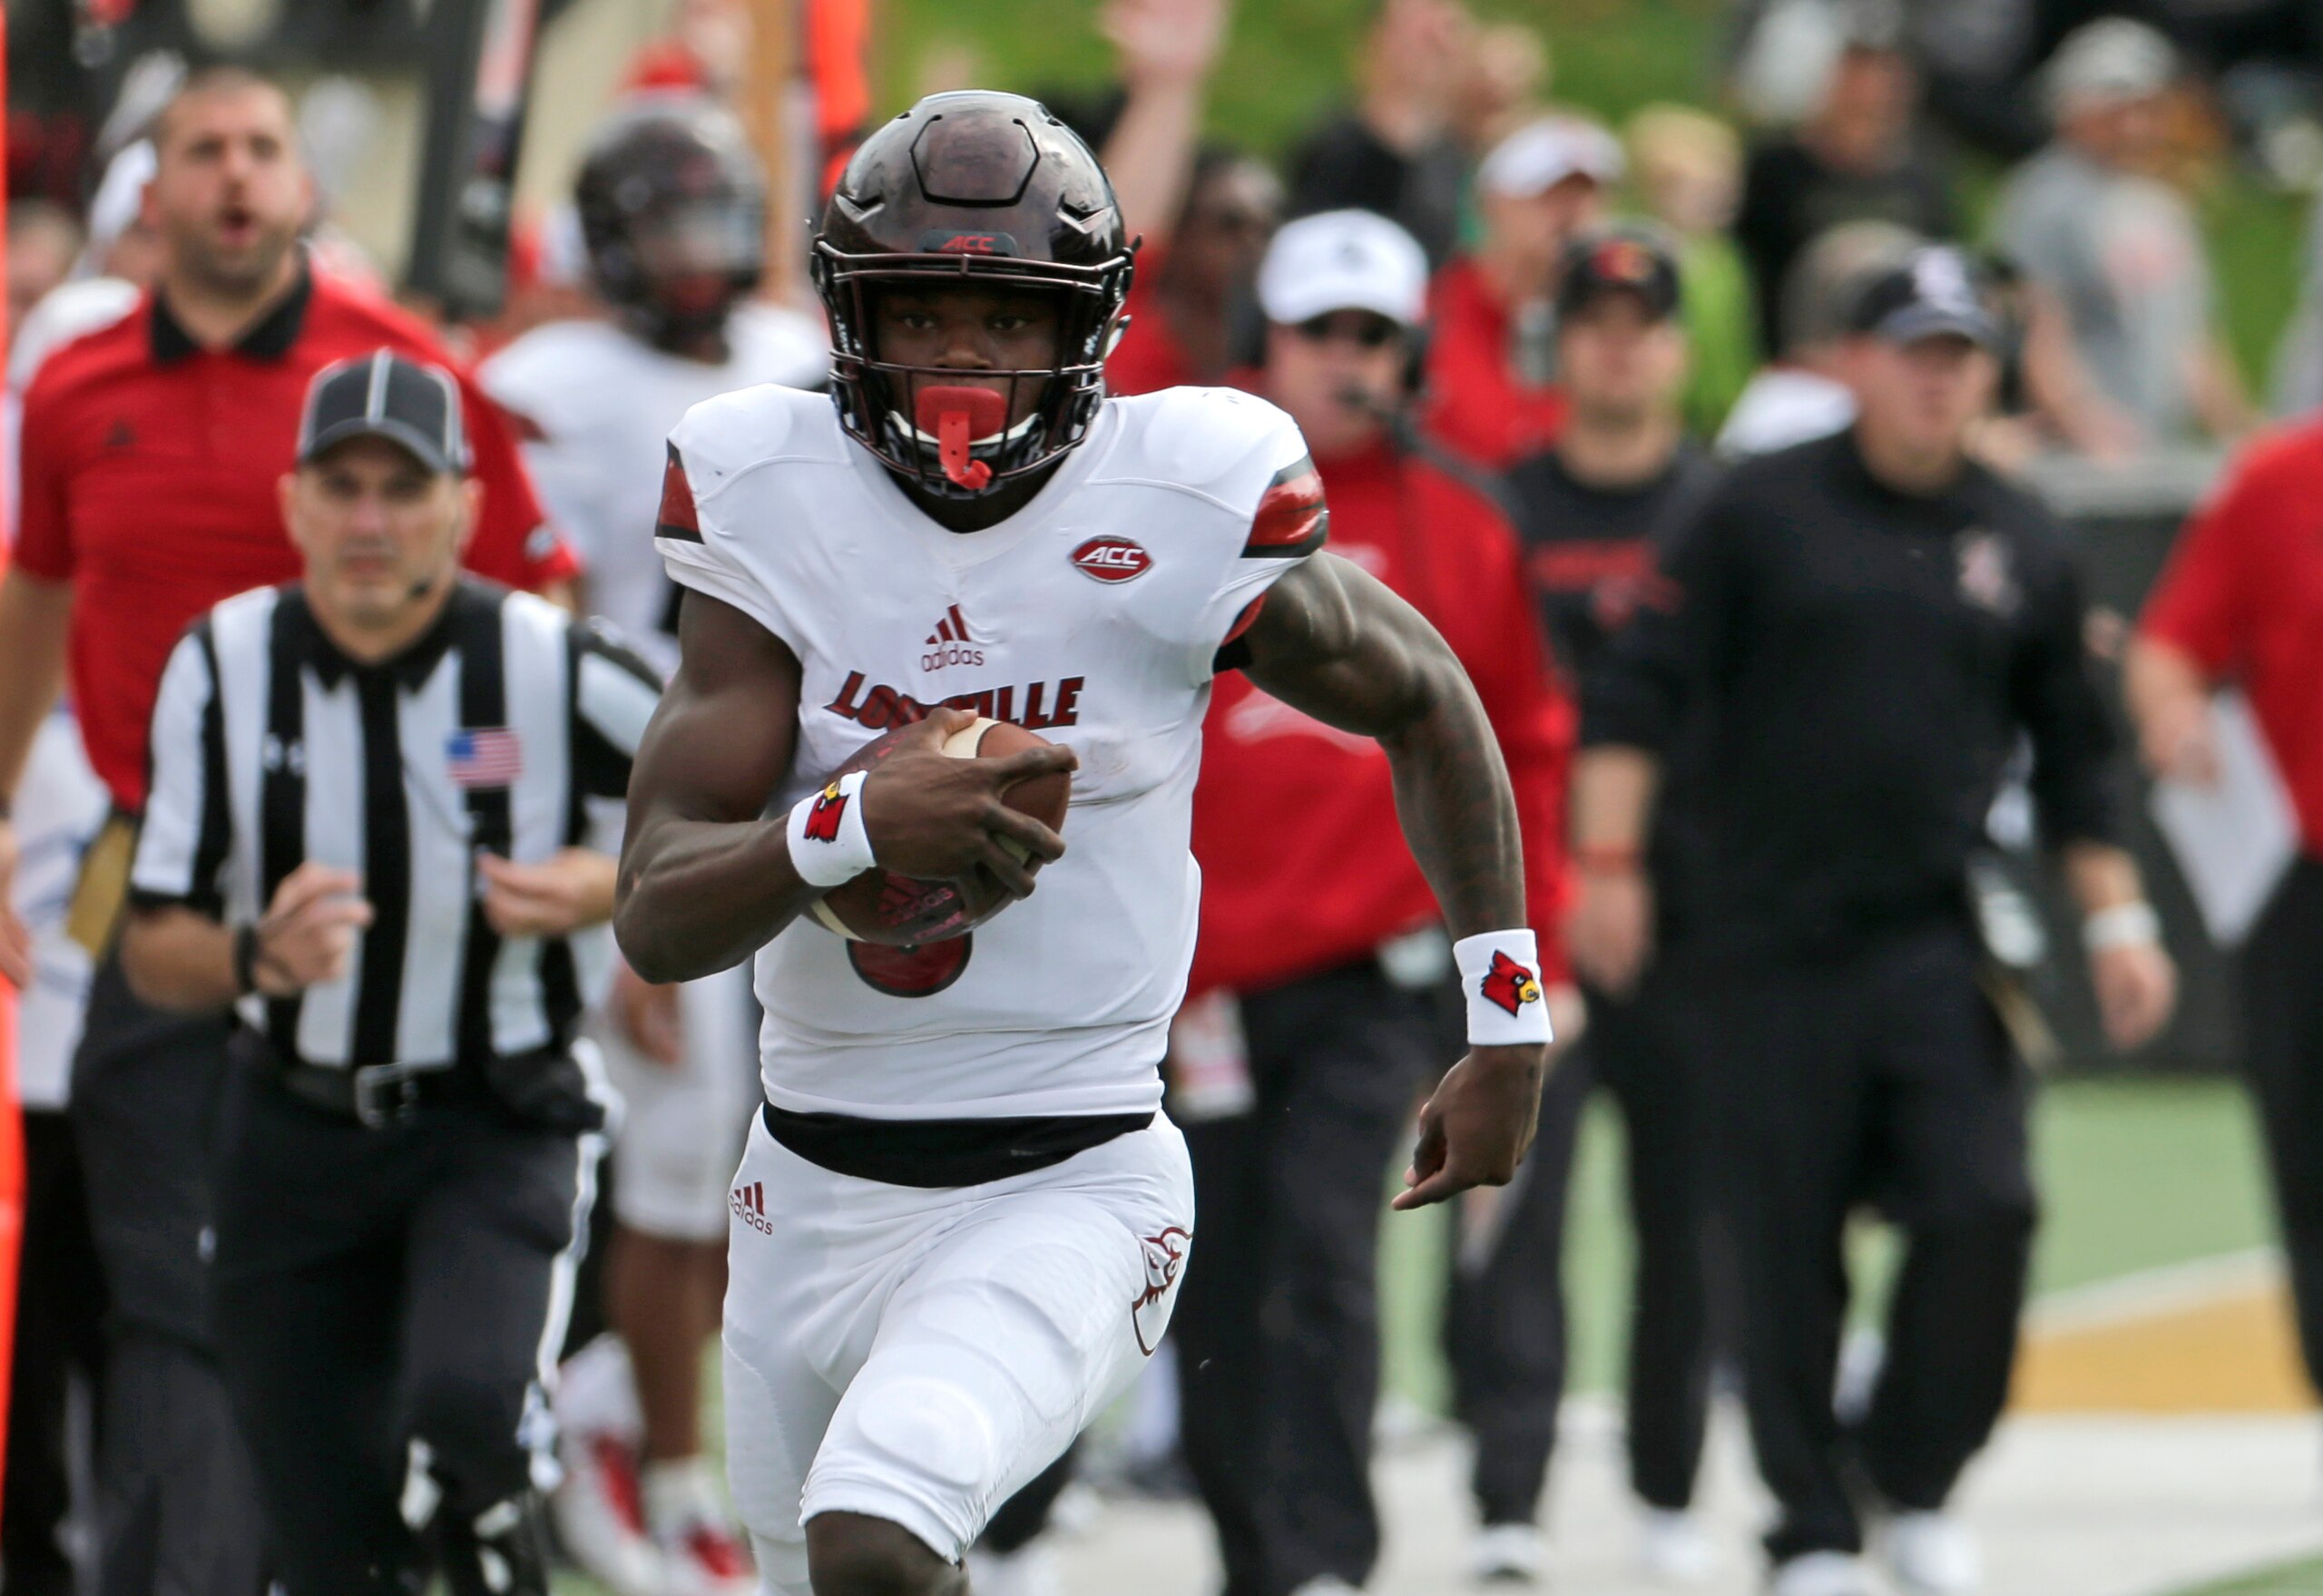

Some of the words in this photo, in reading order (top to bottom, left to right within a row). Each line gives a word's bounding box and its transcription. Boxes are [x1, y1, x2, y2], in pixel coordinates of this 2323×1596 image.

[939, 235, 996, 253] ACC
[1078, 546, 1144, 565] ACC
[921, 643, 984, 672] adidas
[823, 670, 1085, 731] LOUILLE
[729, 1194, 773, 1236] adidas
